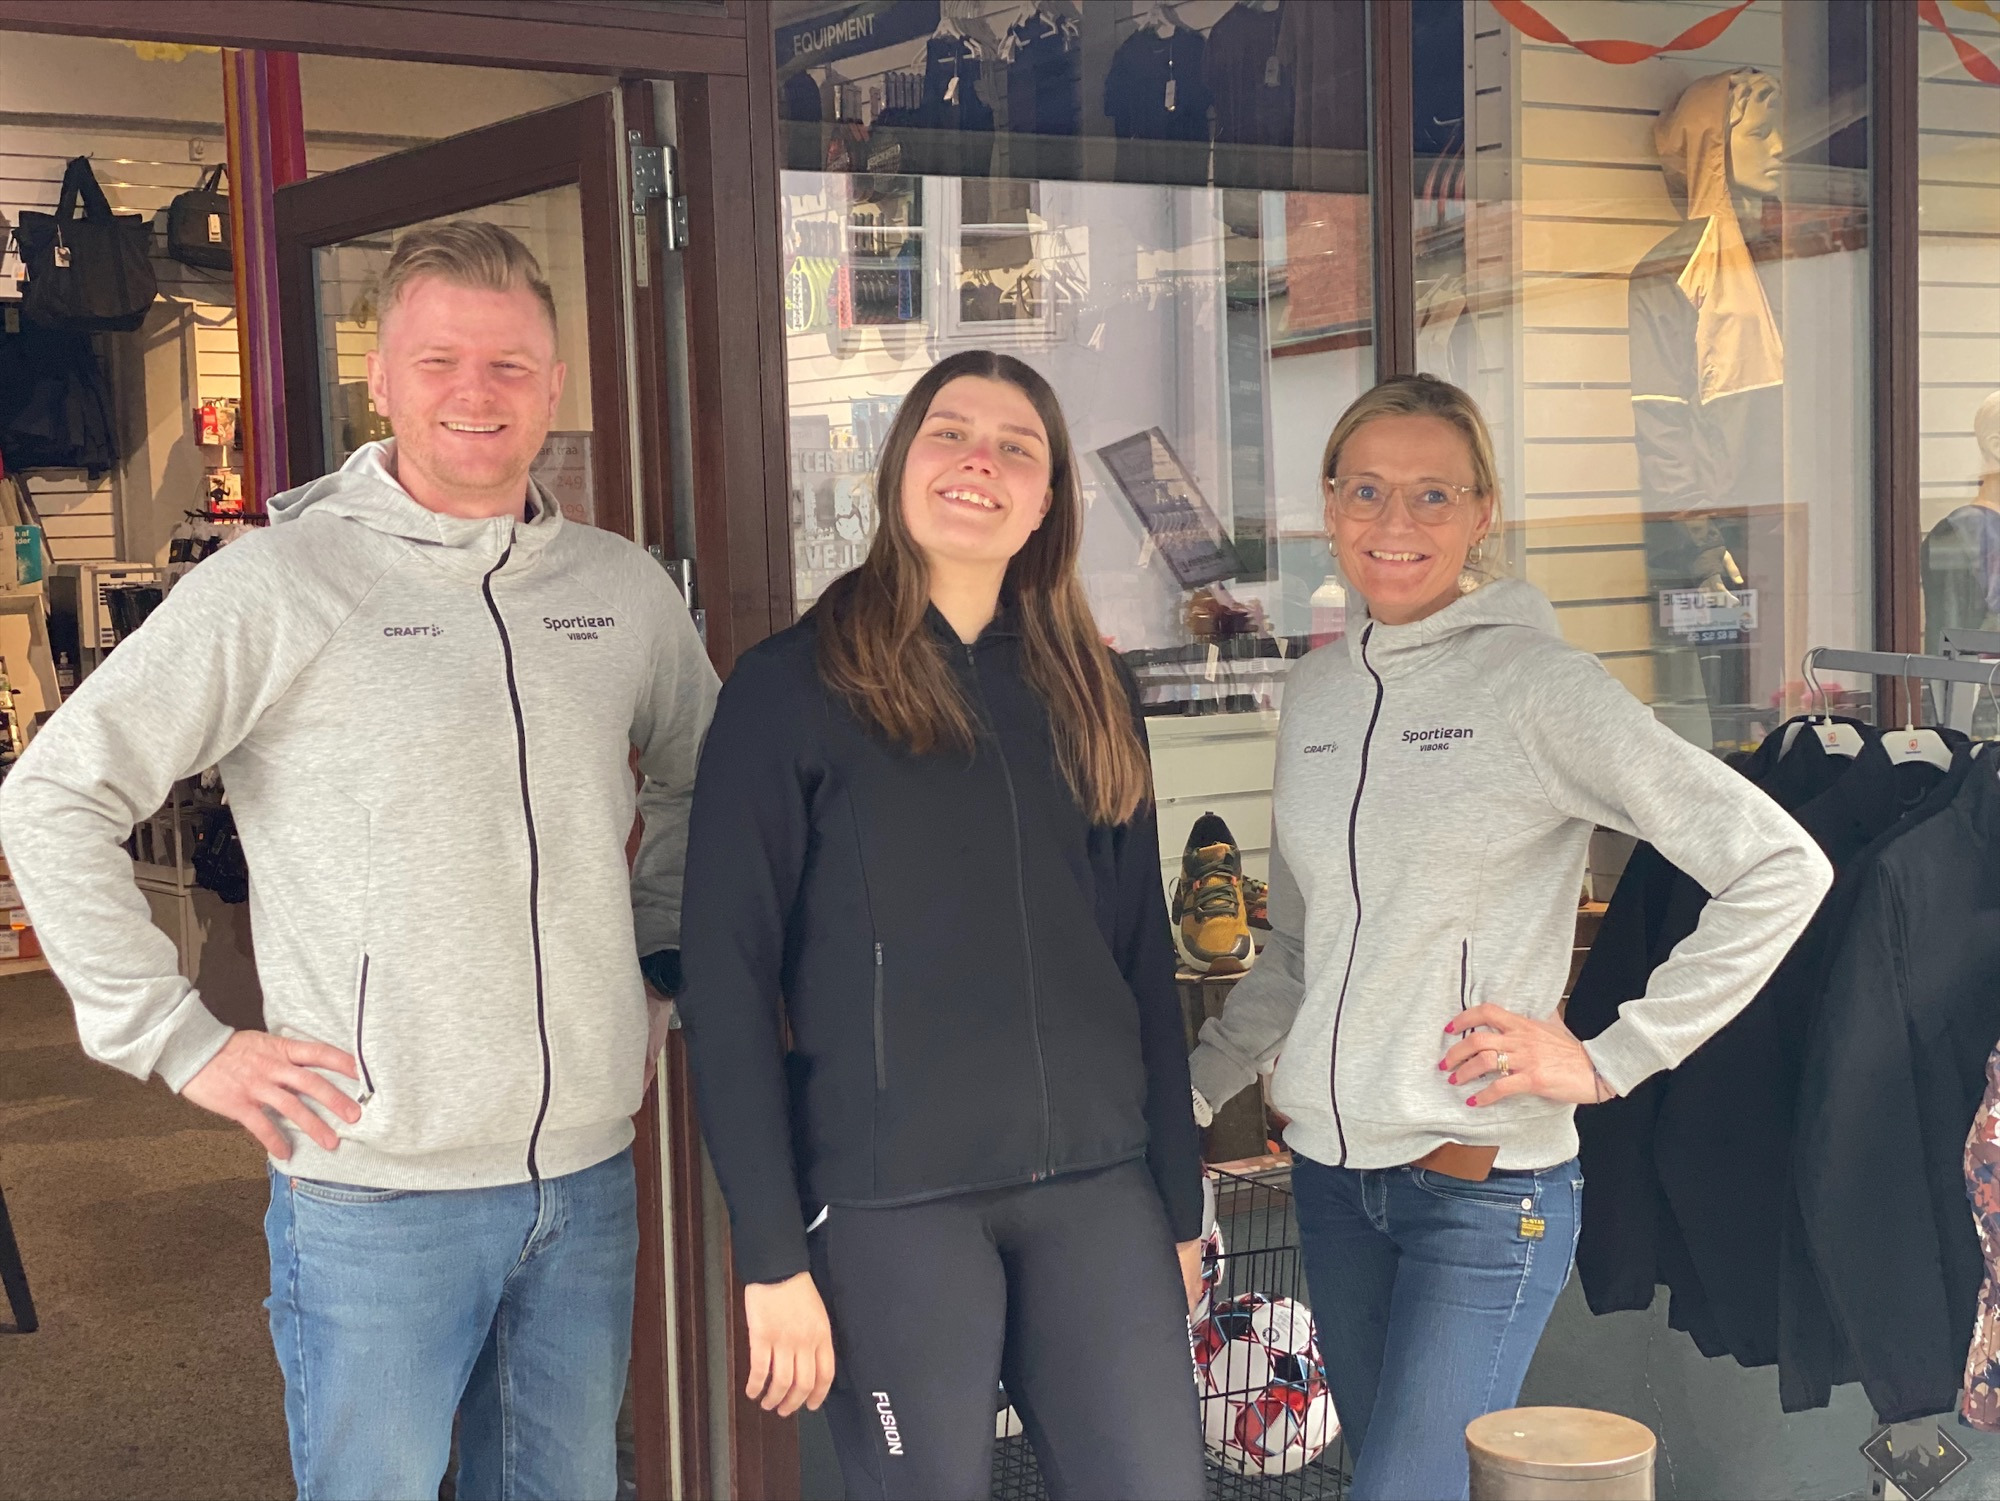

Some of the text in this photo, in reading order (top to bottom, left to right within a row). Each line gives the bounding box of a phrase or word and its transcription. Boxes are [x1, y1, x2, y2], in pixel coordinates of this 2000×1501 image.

[793, 13, 875, 56] EQUIPMENT
[804, 543, 872, 570] VEJL
[543, 615, 615, 631] Sportigan
[383, 626, 430, 637] CRAFT
[567, 632, 599, 641] VIBORG
[1401, 728, 1474, 744] Sportigan
[1303, 744, 1332, 754] CRAFT
[1420, 743, 1450, 752] VIBORG
[872, 1391, 904, 1455] FUSION
